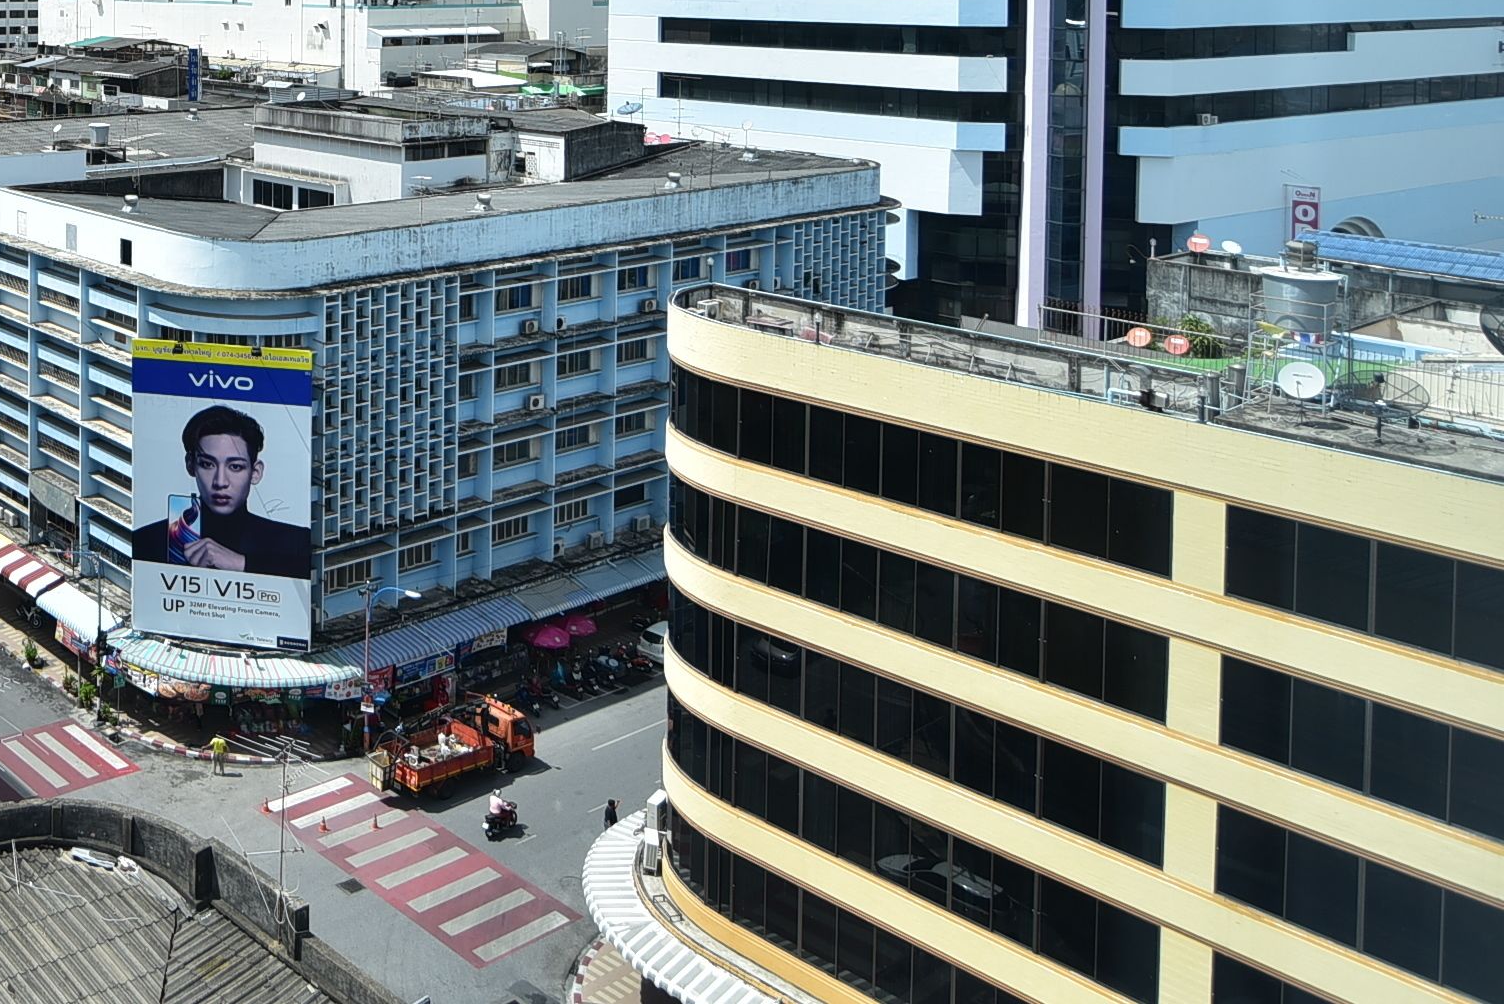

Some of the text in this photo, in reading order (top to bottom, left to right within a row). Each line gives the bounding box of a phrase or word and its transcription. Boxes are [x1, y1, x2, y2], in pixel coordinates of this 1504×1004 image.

[188, 370, 254, 391] vivo
[160, 573, 278, 602] V15 V15 Pro
[163, 598, 185, 612] UP
[189, 601, 206, 609] 32MP
[208, 603, 236, 613] Elevating
[189, 609, 226, 619] Perfect Shot
